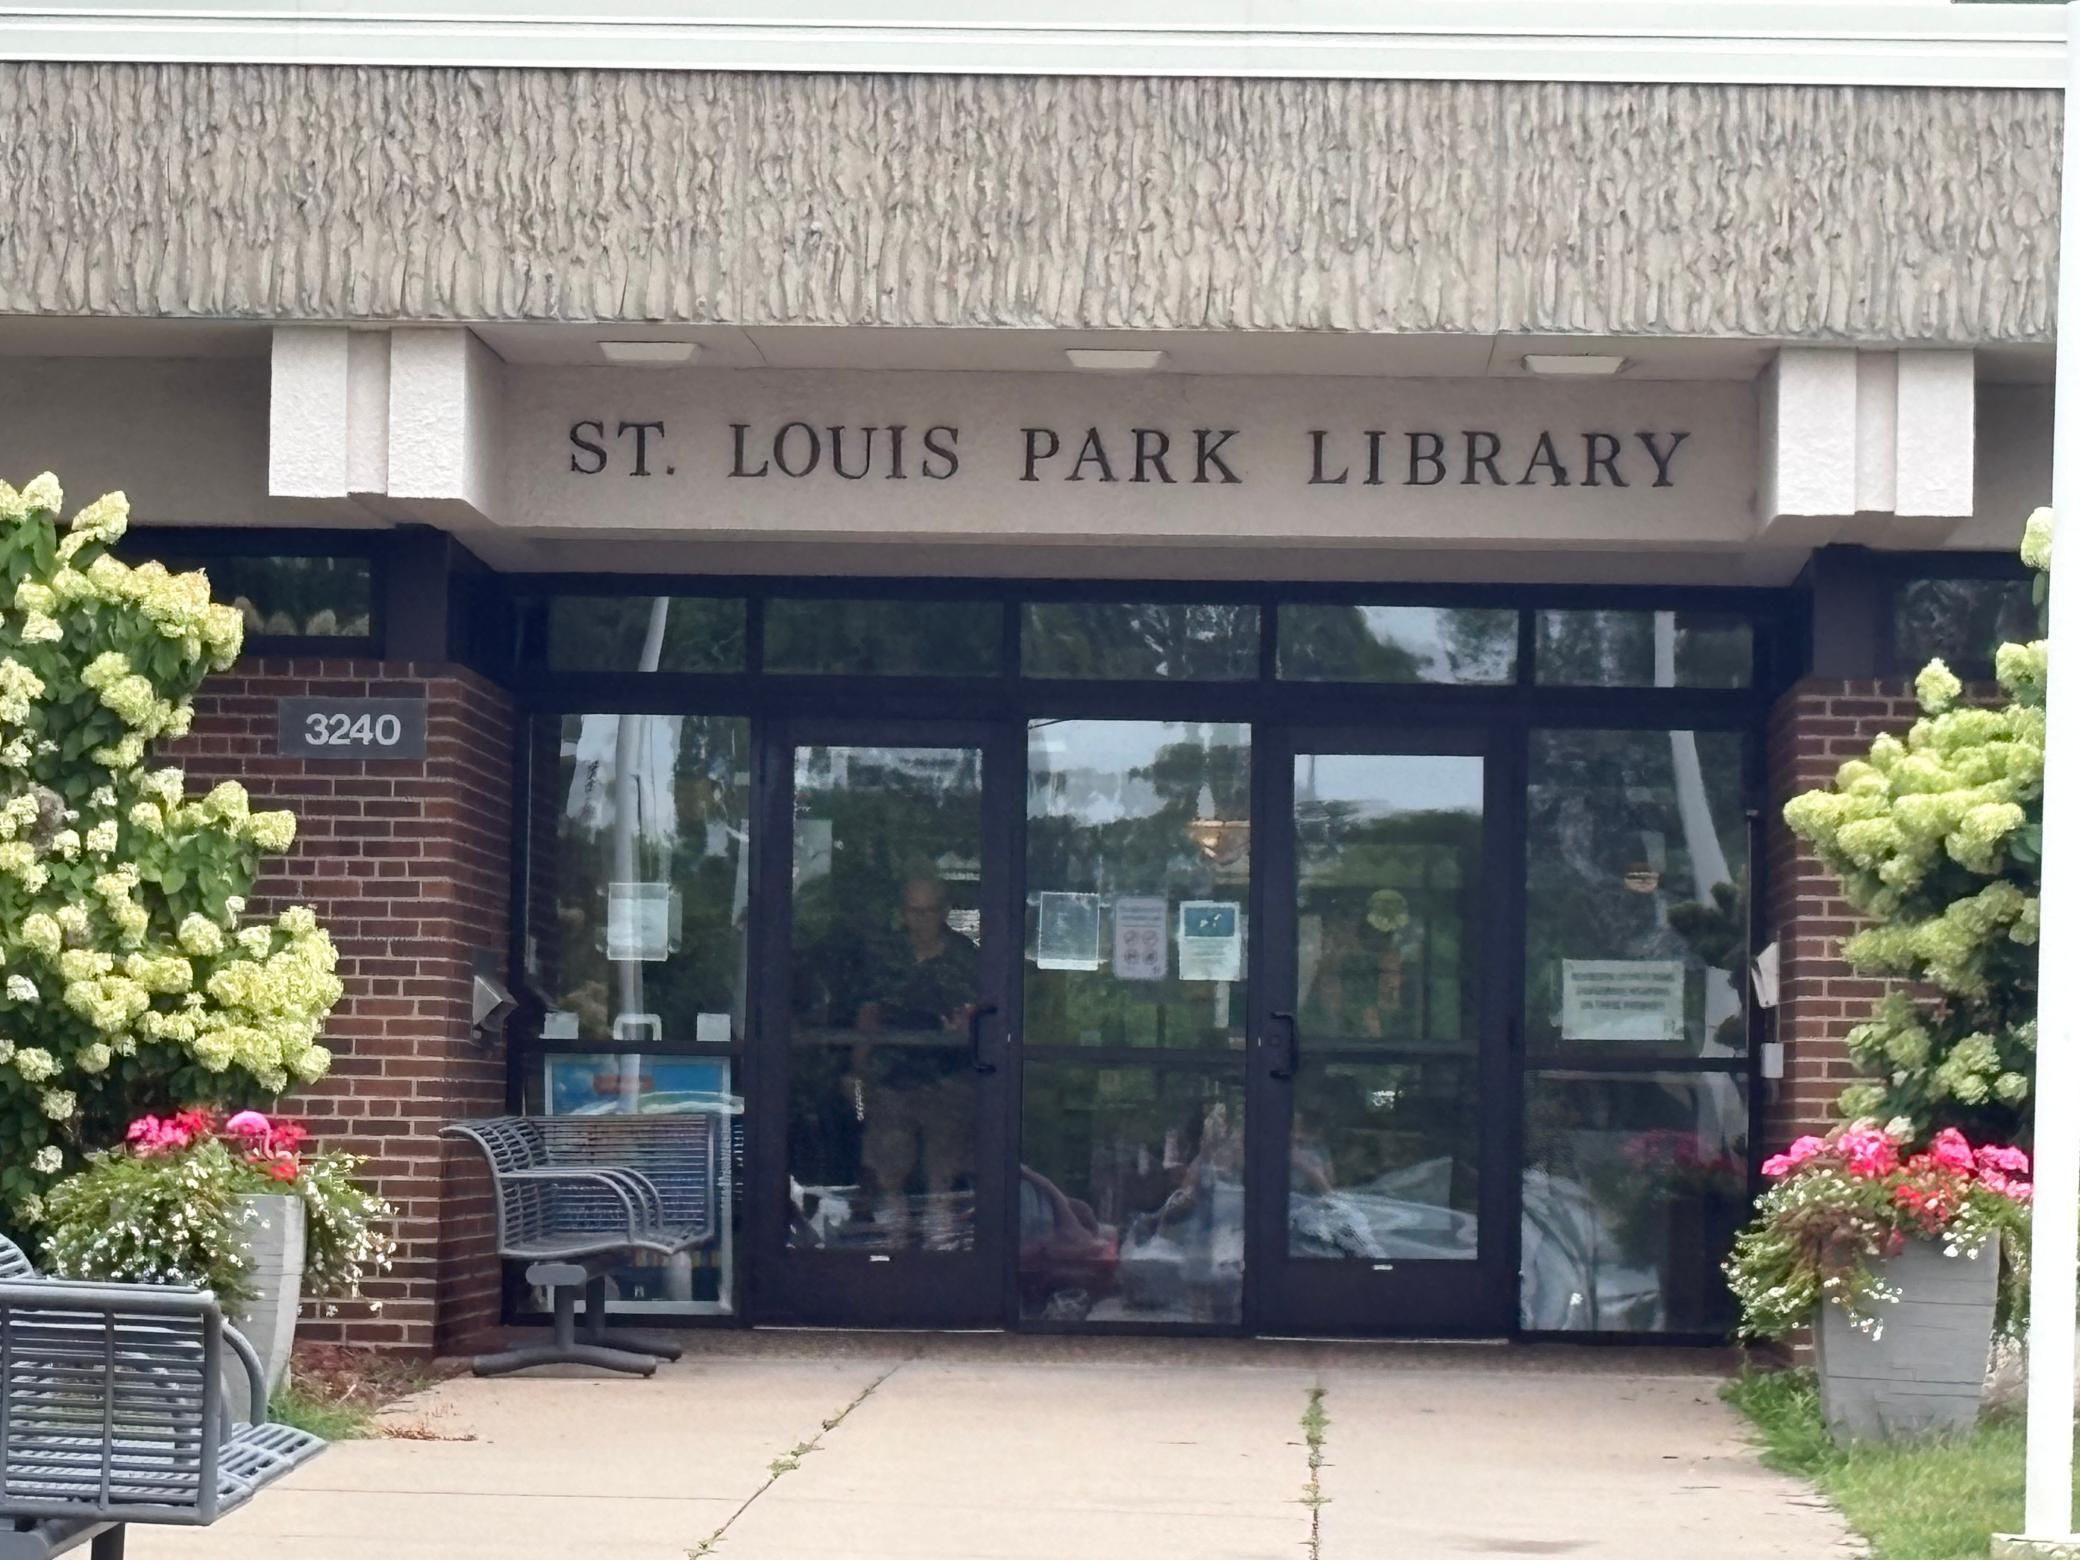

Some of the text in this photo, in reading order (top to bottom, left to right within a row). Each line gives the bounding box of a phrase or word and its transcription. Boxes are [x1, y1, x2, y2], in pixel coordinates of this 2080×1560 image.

[569, 420, 1690, 488] ST. LOUIS PARK LIBRARY
[304, 713, 401, 746] 3240
